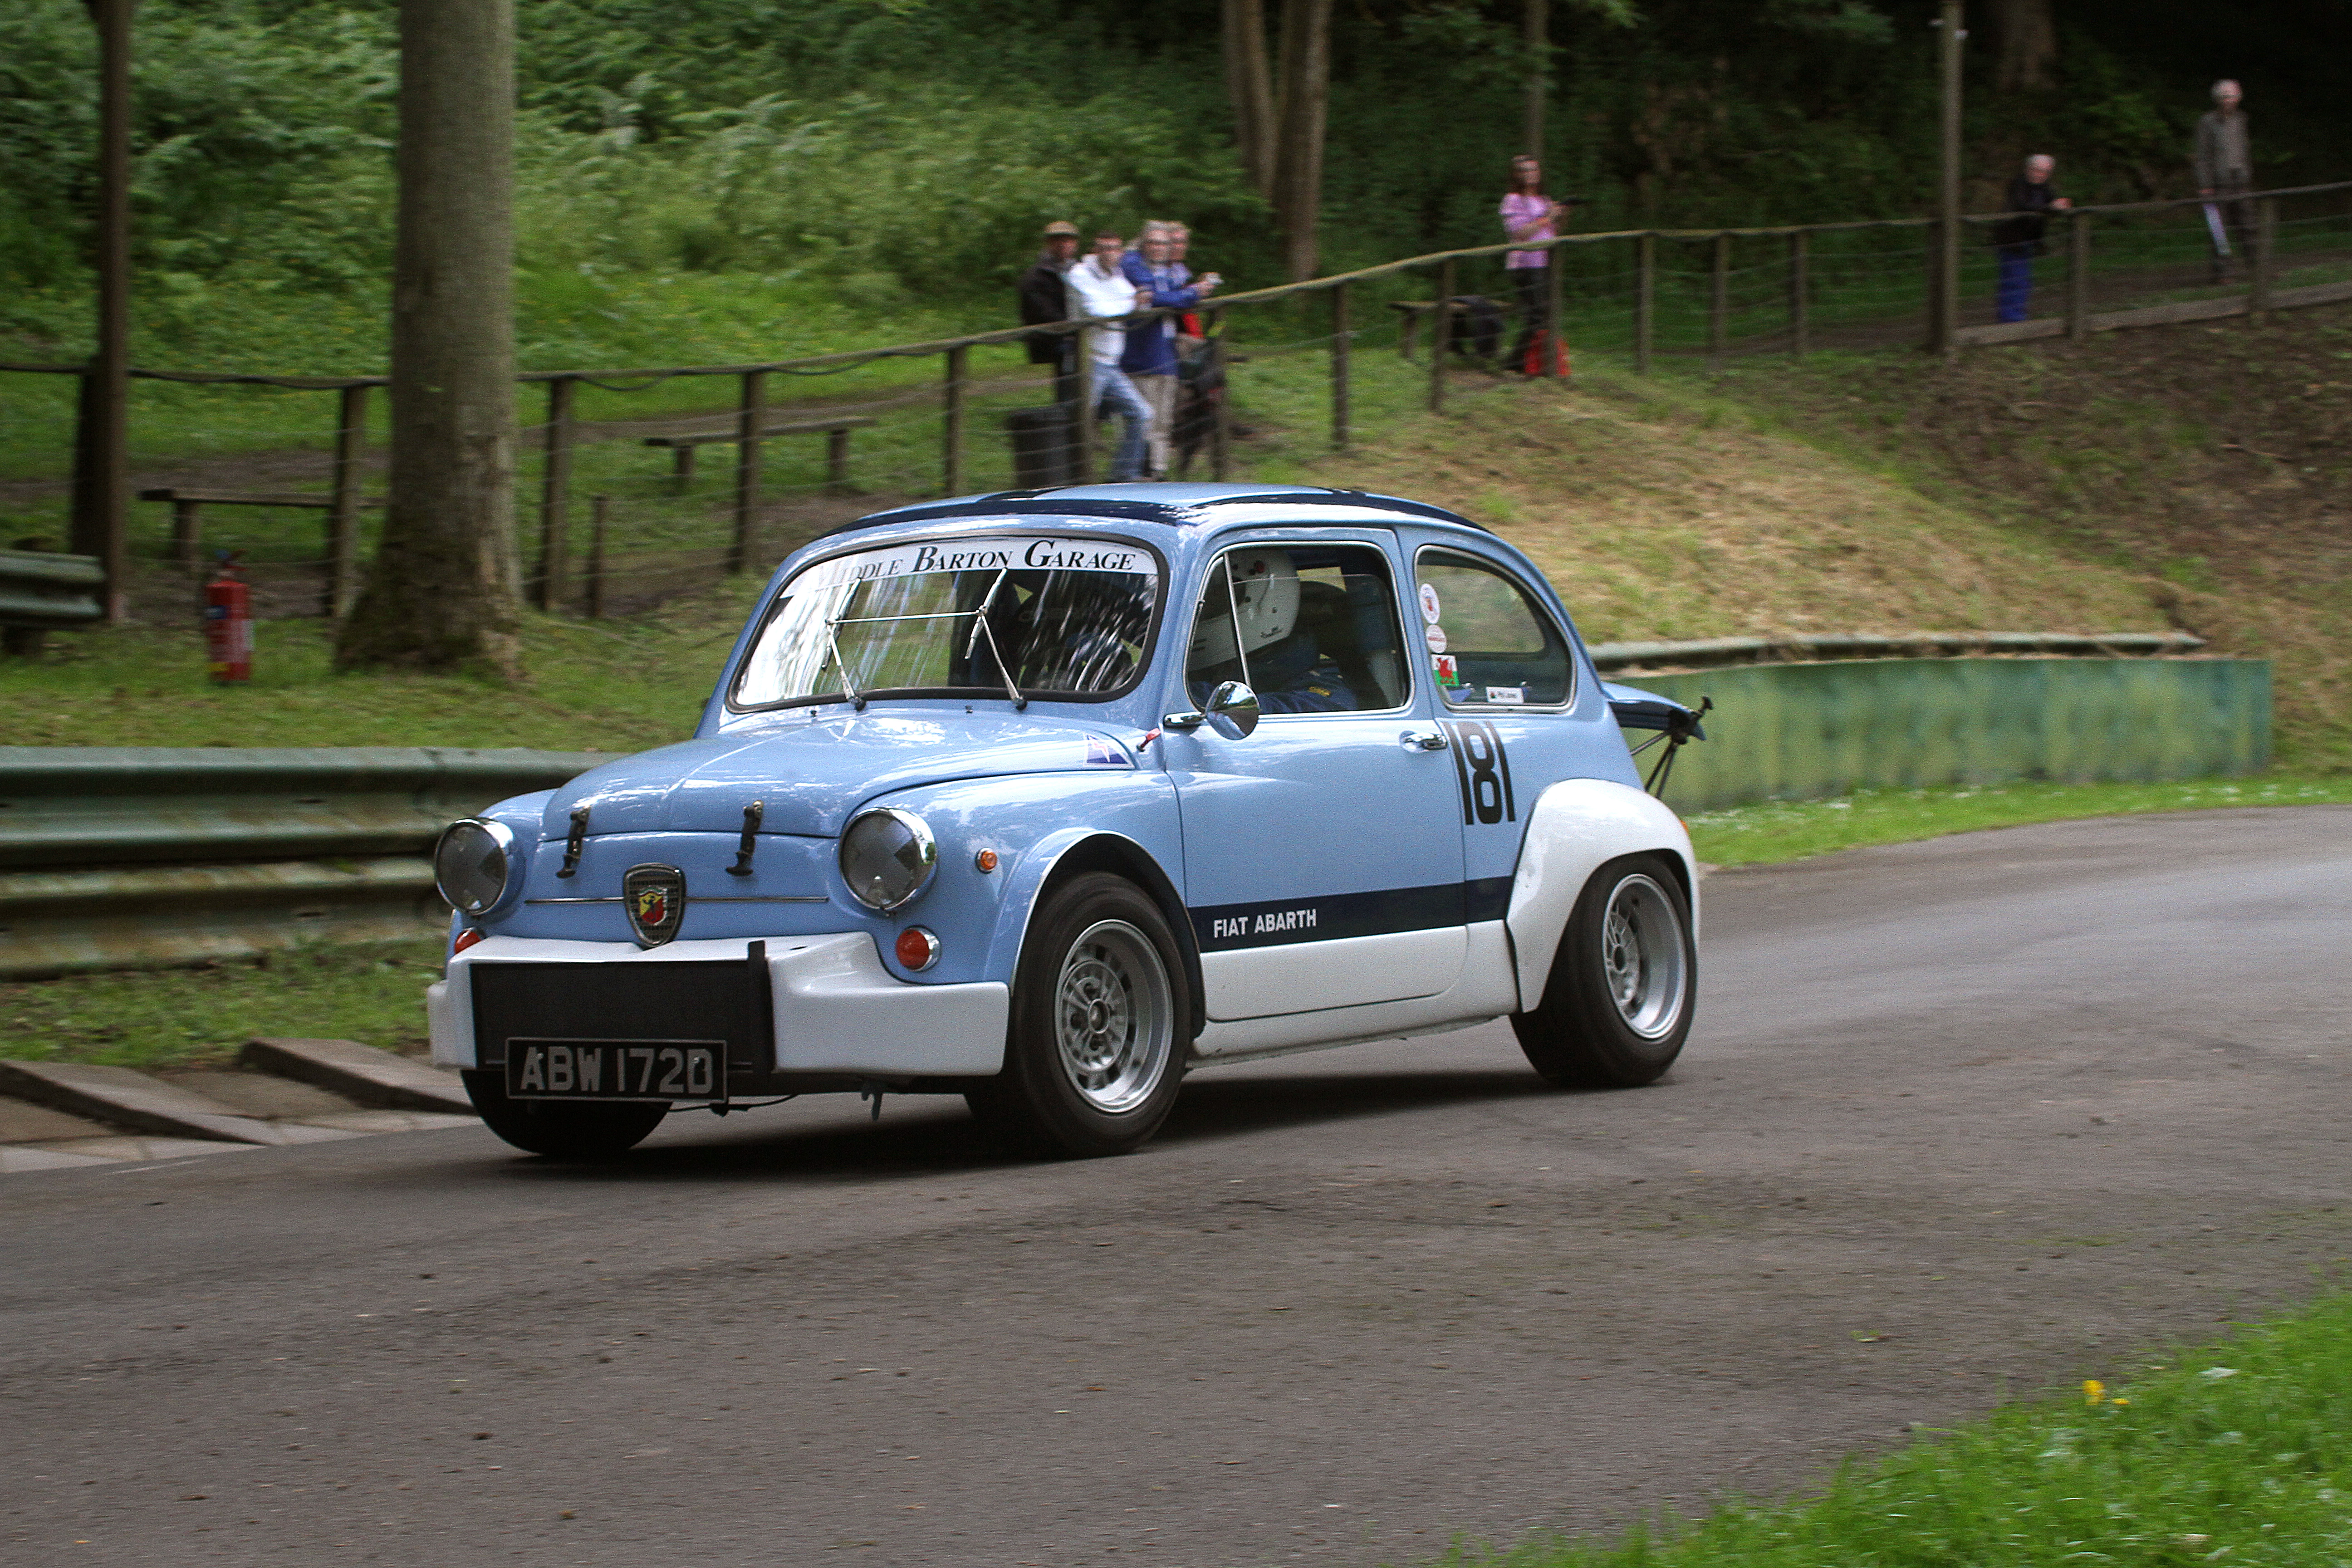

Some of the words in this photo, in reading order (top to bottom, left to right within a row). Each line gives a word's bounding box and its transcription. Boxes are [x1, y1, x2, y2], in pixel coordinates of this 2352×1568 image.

[912, 546, 1012, 572] BARTON
[1024, 539, 1135, 570] GARAGE
[1442, 720, 1516, 825] 181
[1213, 916, 1248, 938] FIAT
[1254, 908, 1316, 933] ABARTH
[520, 1046, 602, 1091] ABW
[617, 1047, 713, 1093] 172D
